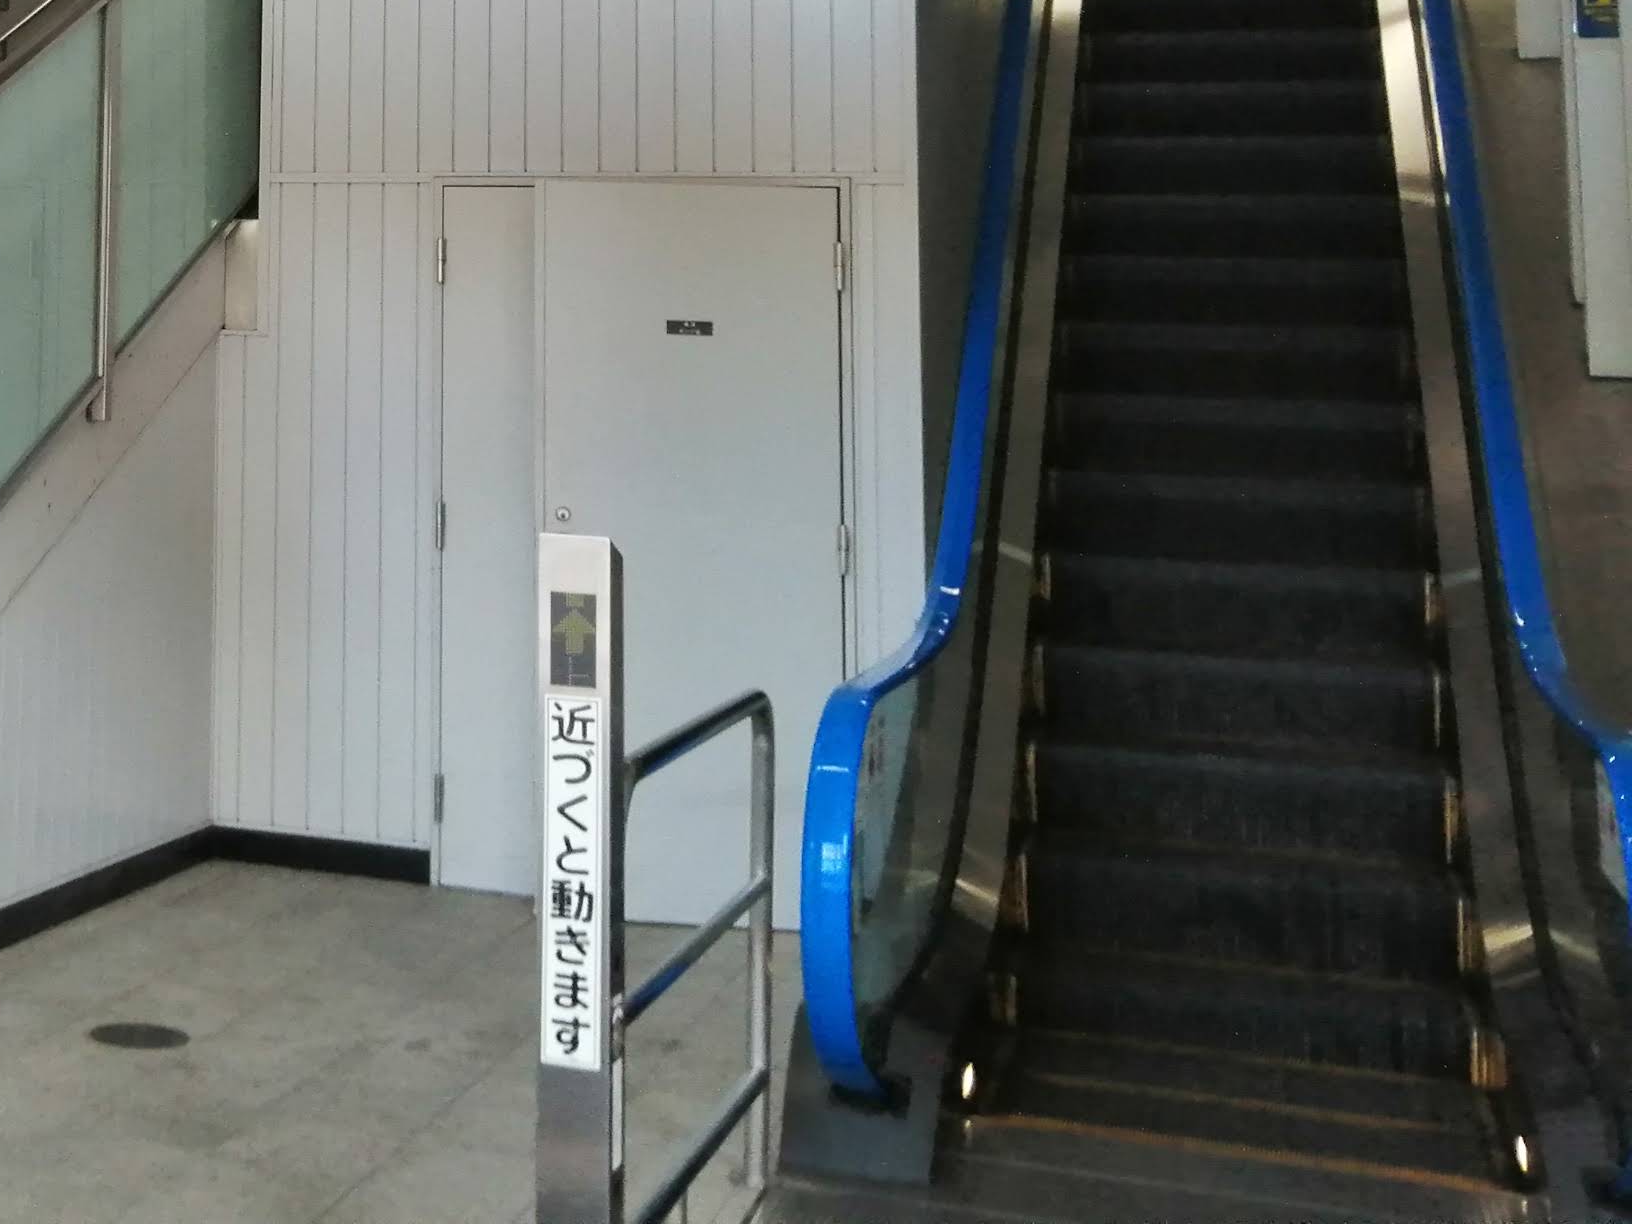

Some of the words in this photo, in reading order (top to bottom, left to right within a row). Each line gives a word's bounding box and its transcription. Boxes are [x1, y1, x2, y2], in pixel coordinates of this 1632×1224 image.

[550, 702, 595, 1055] 近づくと動きます
